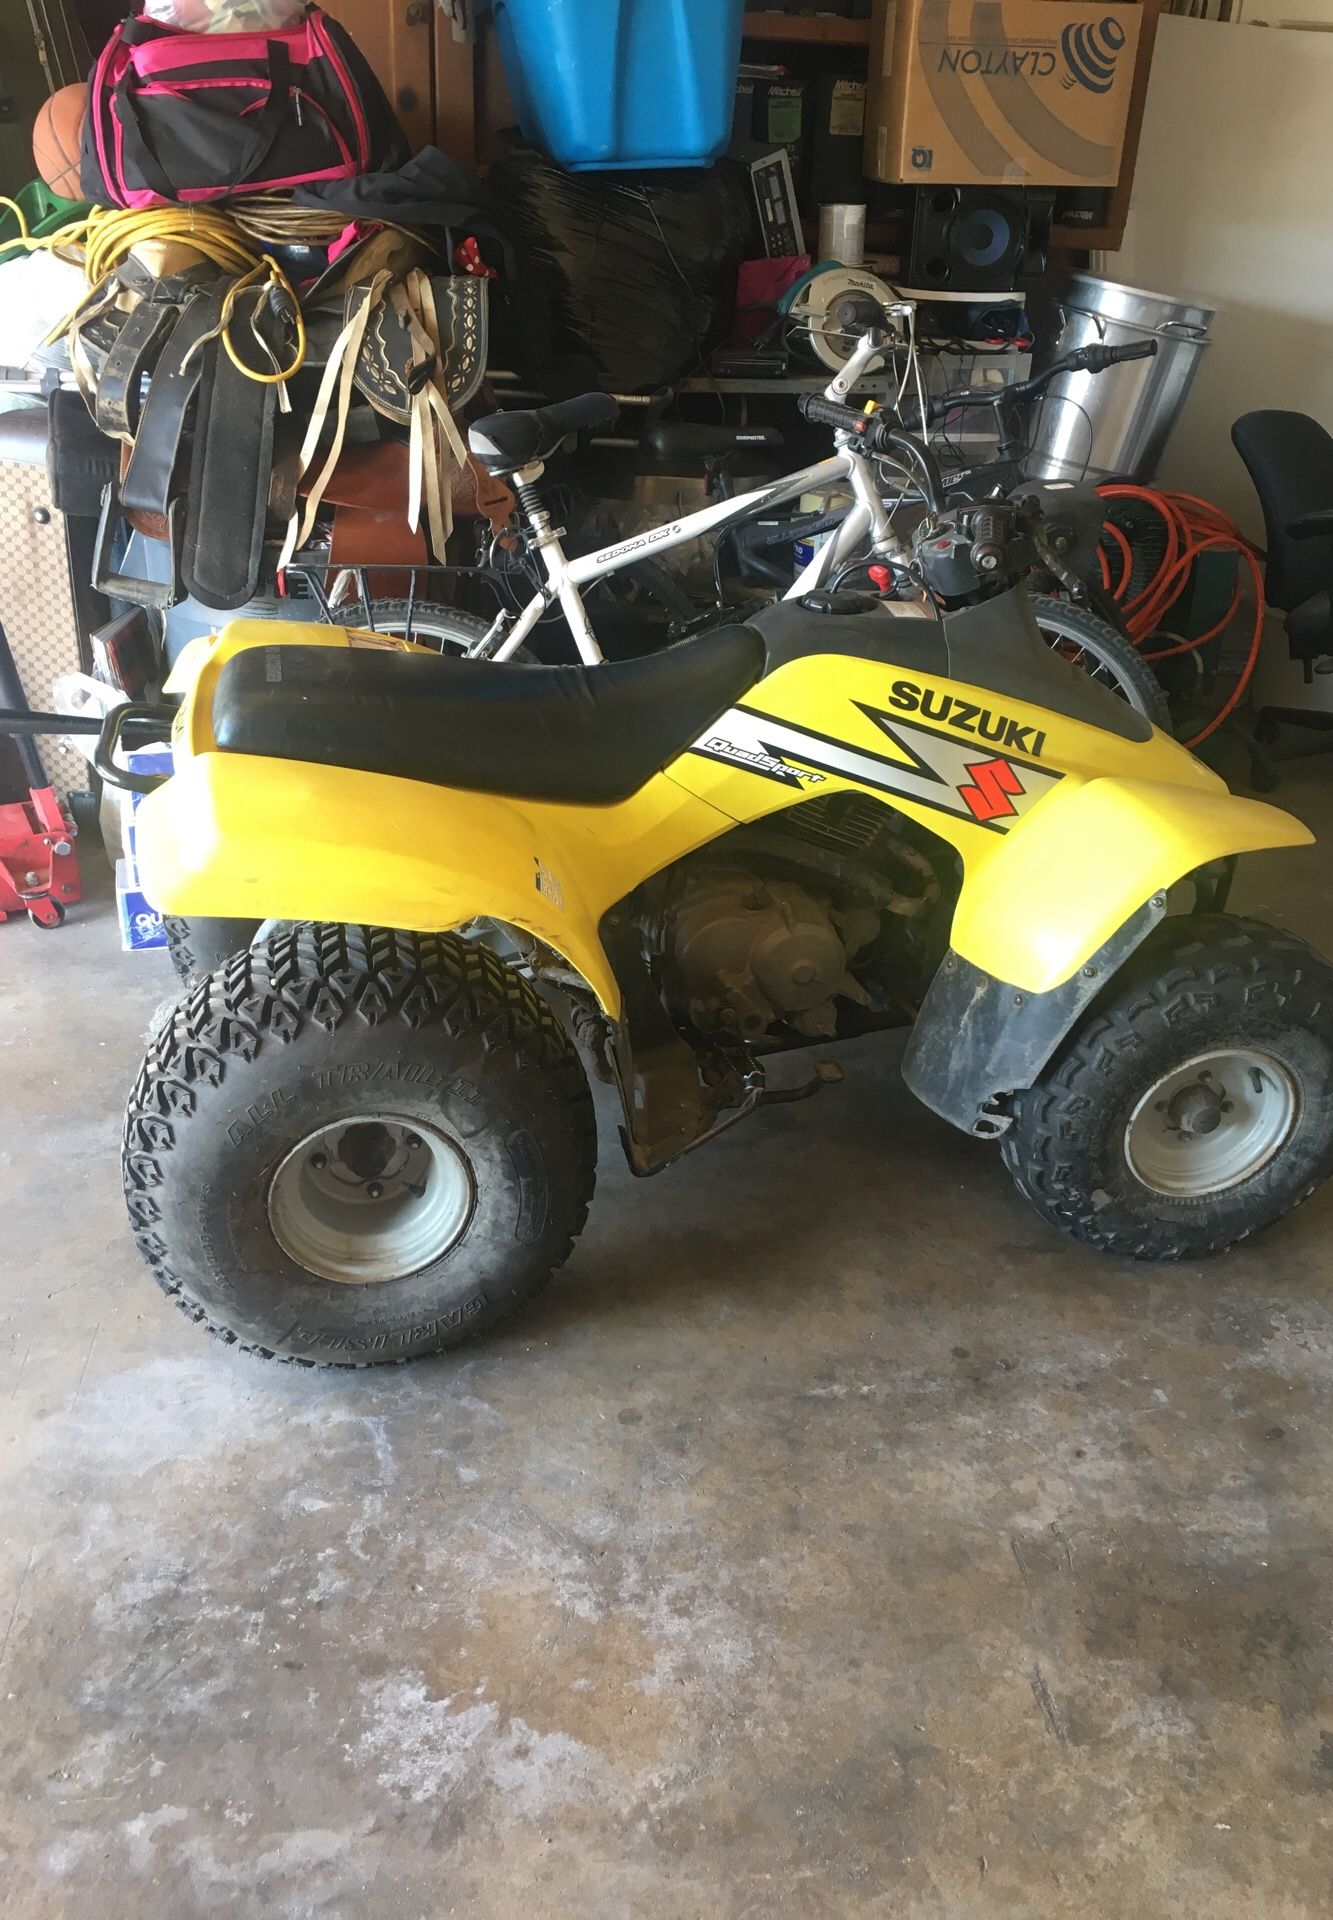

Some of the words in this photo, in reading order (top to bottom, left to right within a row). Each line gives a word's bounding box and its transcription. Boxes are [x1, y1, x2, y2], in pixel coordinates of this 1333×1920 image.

[937, 49, 1057, 76] CLAYTON
[596, 539, 647, 564] SEDONA
[888, 680, 1047, 757] SUZUKI
[703, 736, 827, 783] QuadSport
[227, 1088, 297, 1149] ALL
[311, 1062, 444, 1089] TRAIL
